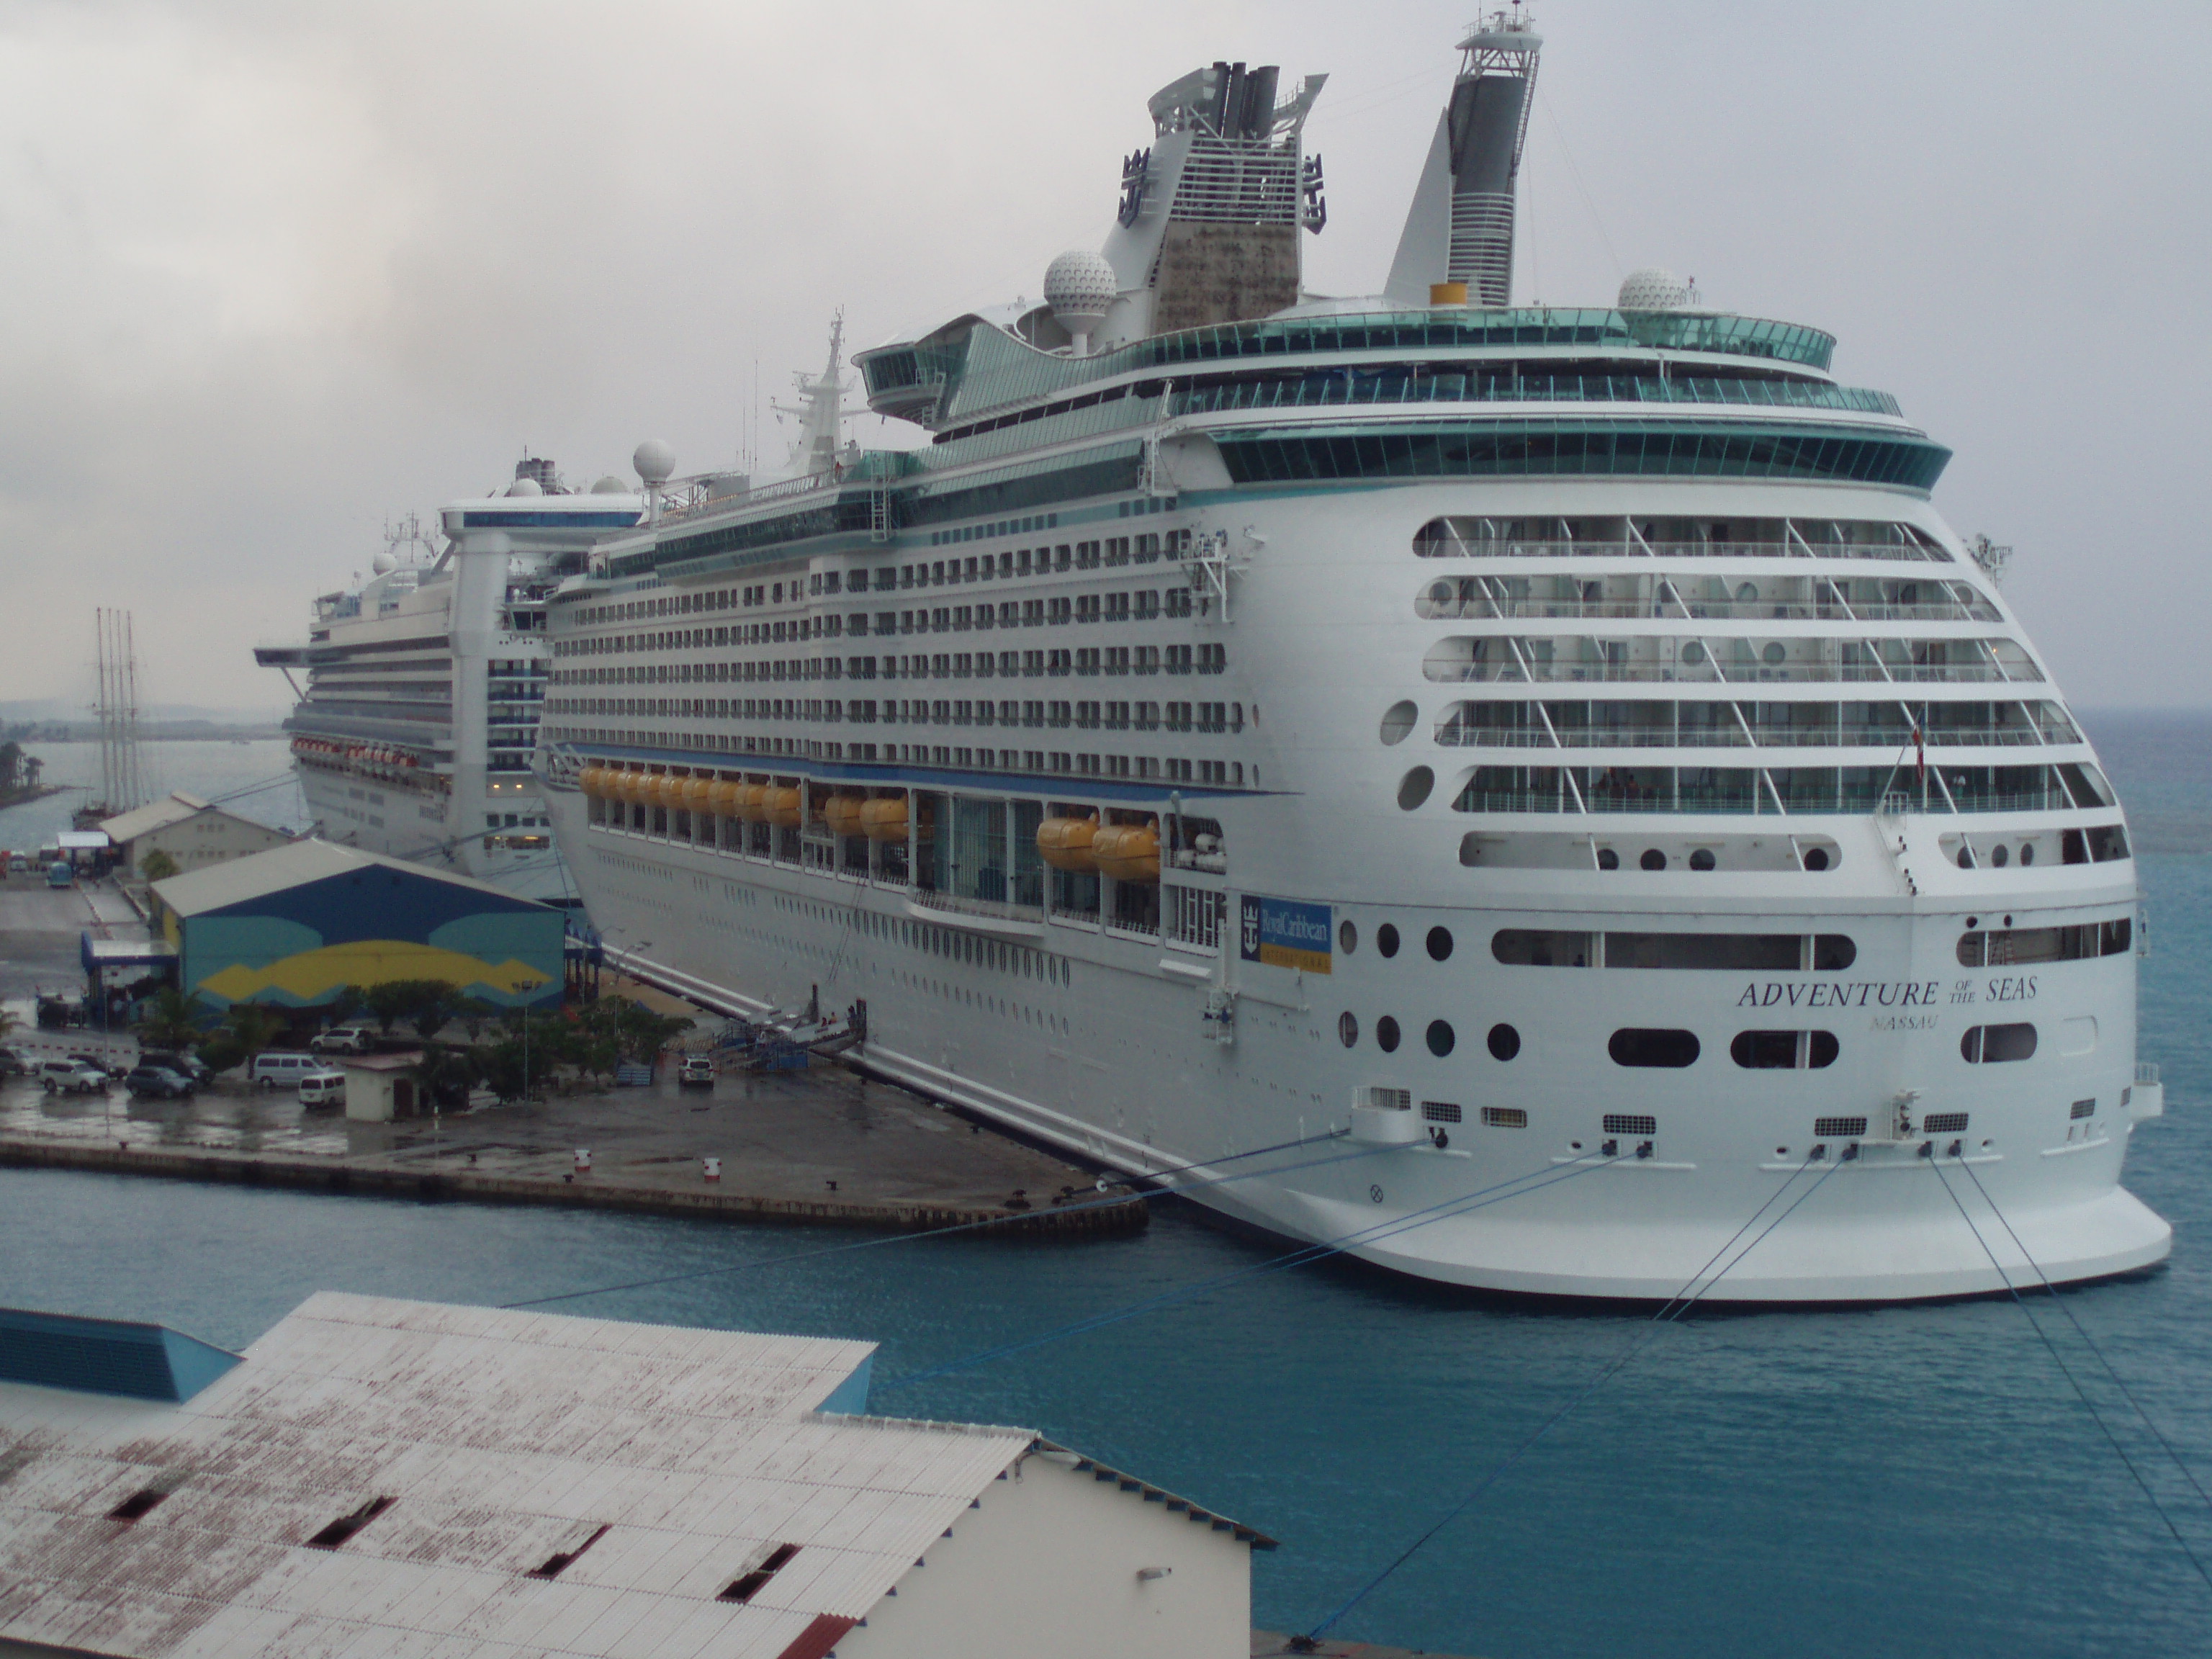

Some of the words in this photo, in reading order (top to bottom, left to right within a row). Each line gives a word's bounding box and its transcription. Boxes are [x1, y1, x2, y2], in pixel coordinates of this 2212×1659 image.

[1282, 912, 1327, 941] Caribbean
[1735, 981, 1940, 1007] ADVENTURE
[1955, 979, 1972, 991] OF
[1985, 975, 2038, 1002] SEAS
[1948, 992, 1977, 1004] THE
[1870, 1014, 1939, 1031] NASSAU
